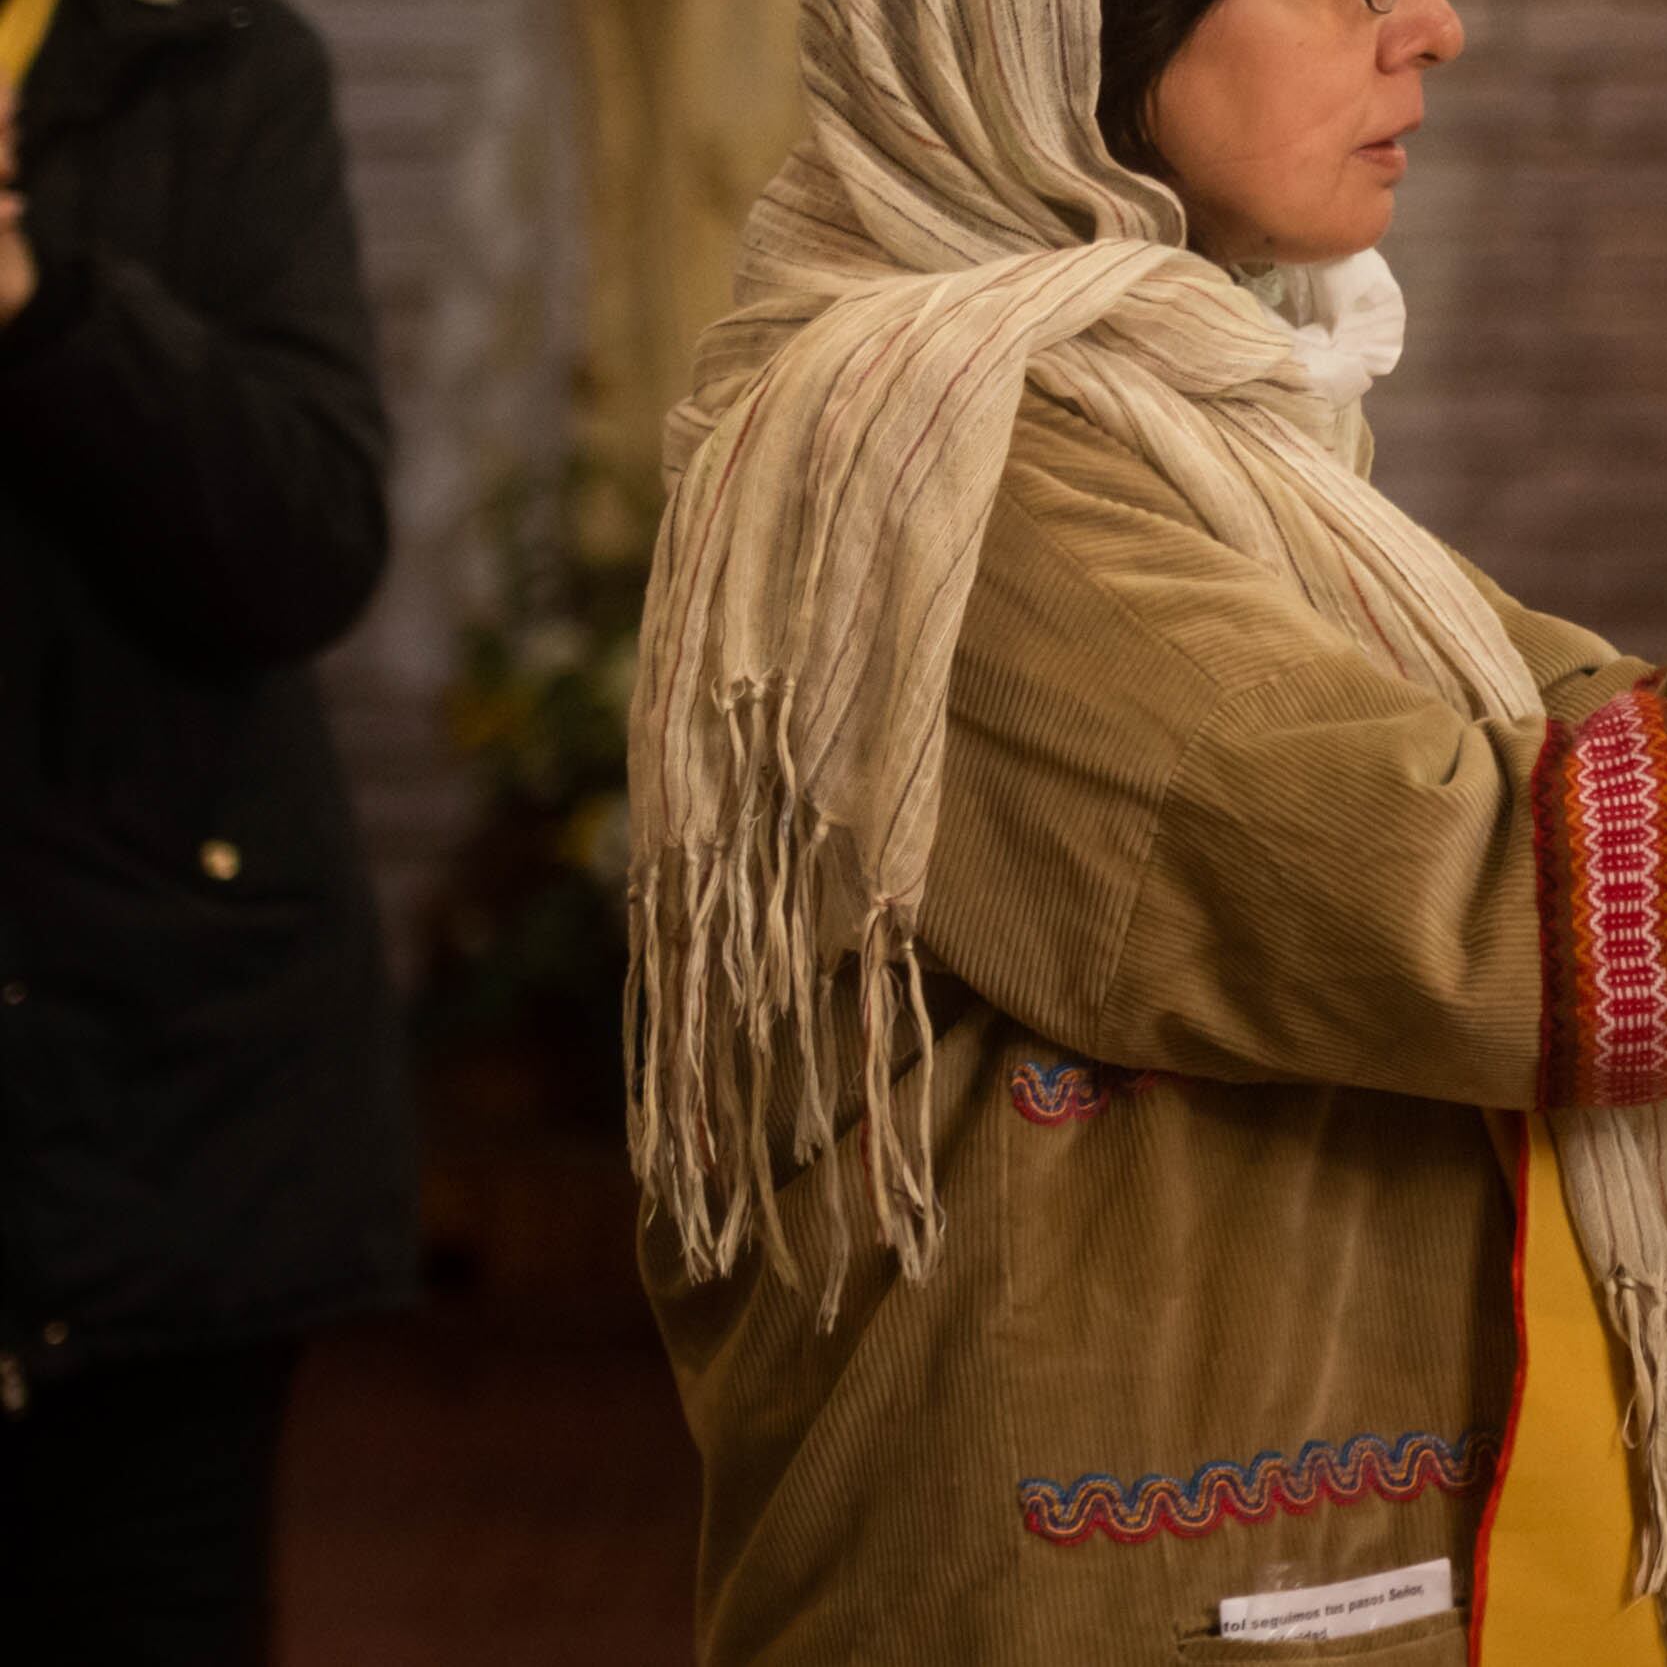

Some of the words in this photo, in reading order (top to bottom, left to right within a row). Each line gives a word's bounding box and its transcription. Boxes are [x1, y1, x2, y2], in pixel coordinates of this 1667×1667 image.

[1251, 1608, 1320, 1630] seguimos
[1325, 1603, 1345, 1615] tus
[1349, 1594, 1384, 1614] pasos
